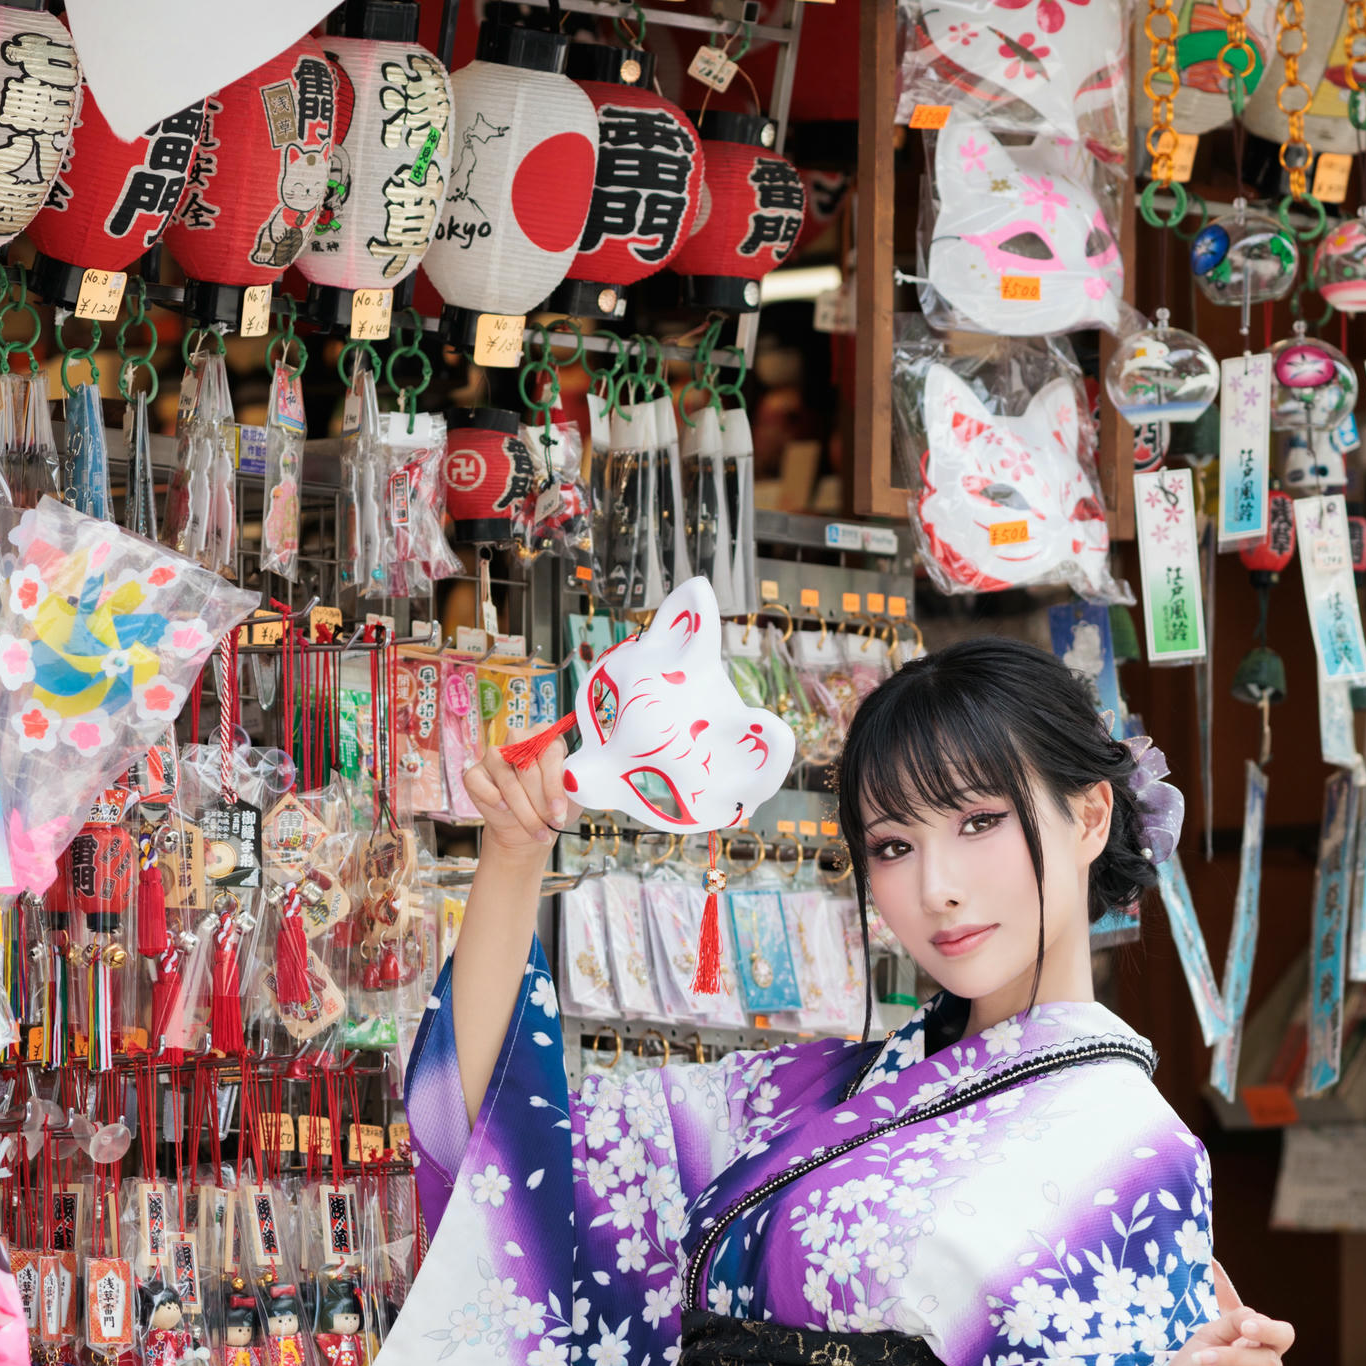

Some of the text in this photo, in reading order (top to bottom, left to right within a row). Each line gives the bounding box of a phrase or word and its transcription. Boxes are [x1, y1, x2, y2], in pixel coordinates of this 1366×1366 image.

[271, 92, 295, 137] 浅草
[293, 56, 335, 142] 雷門
[578, 104, 699, 264] 雷門
[736, 156, 806, 261] 雷門
[435, 215, 493, 250] okyo
[83, 271, 110, 286] No.3
[1001, 281, 1038, 299] ¥500
[991, 526, 1029, 545] ¥500
[1165, 566, 1190, 642] 江戸風鈴
[418, 665, 438, 738] 風水招き
[507, 677, 528, 730] 風水招
[71, 834, 99, 899] 雷門
[102, 1276, 116, 1329] 浅草雷門
